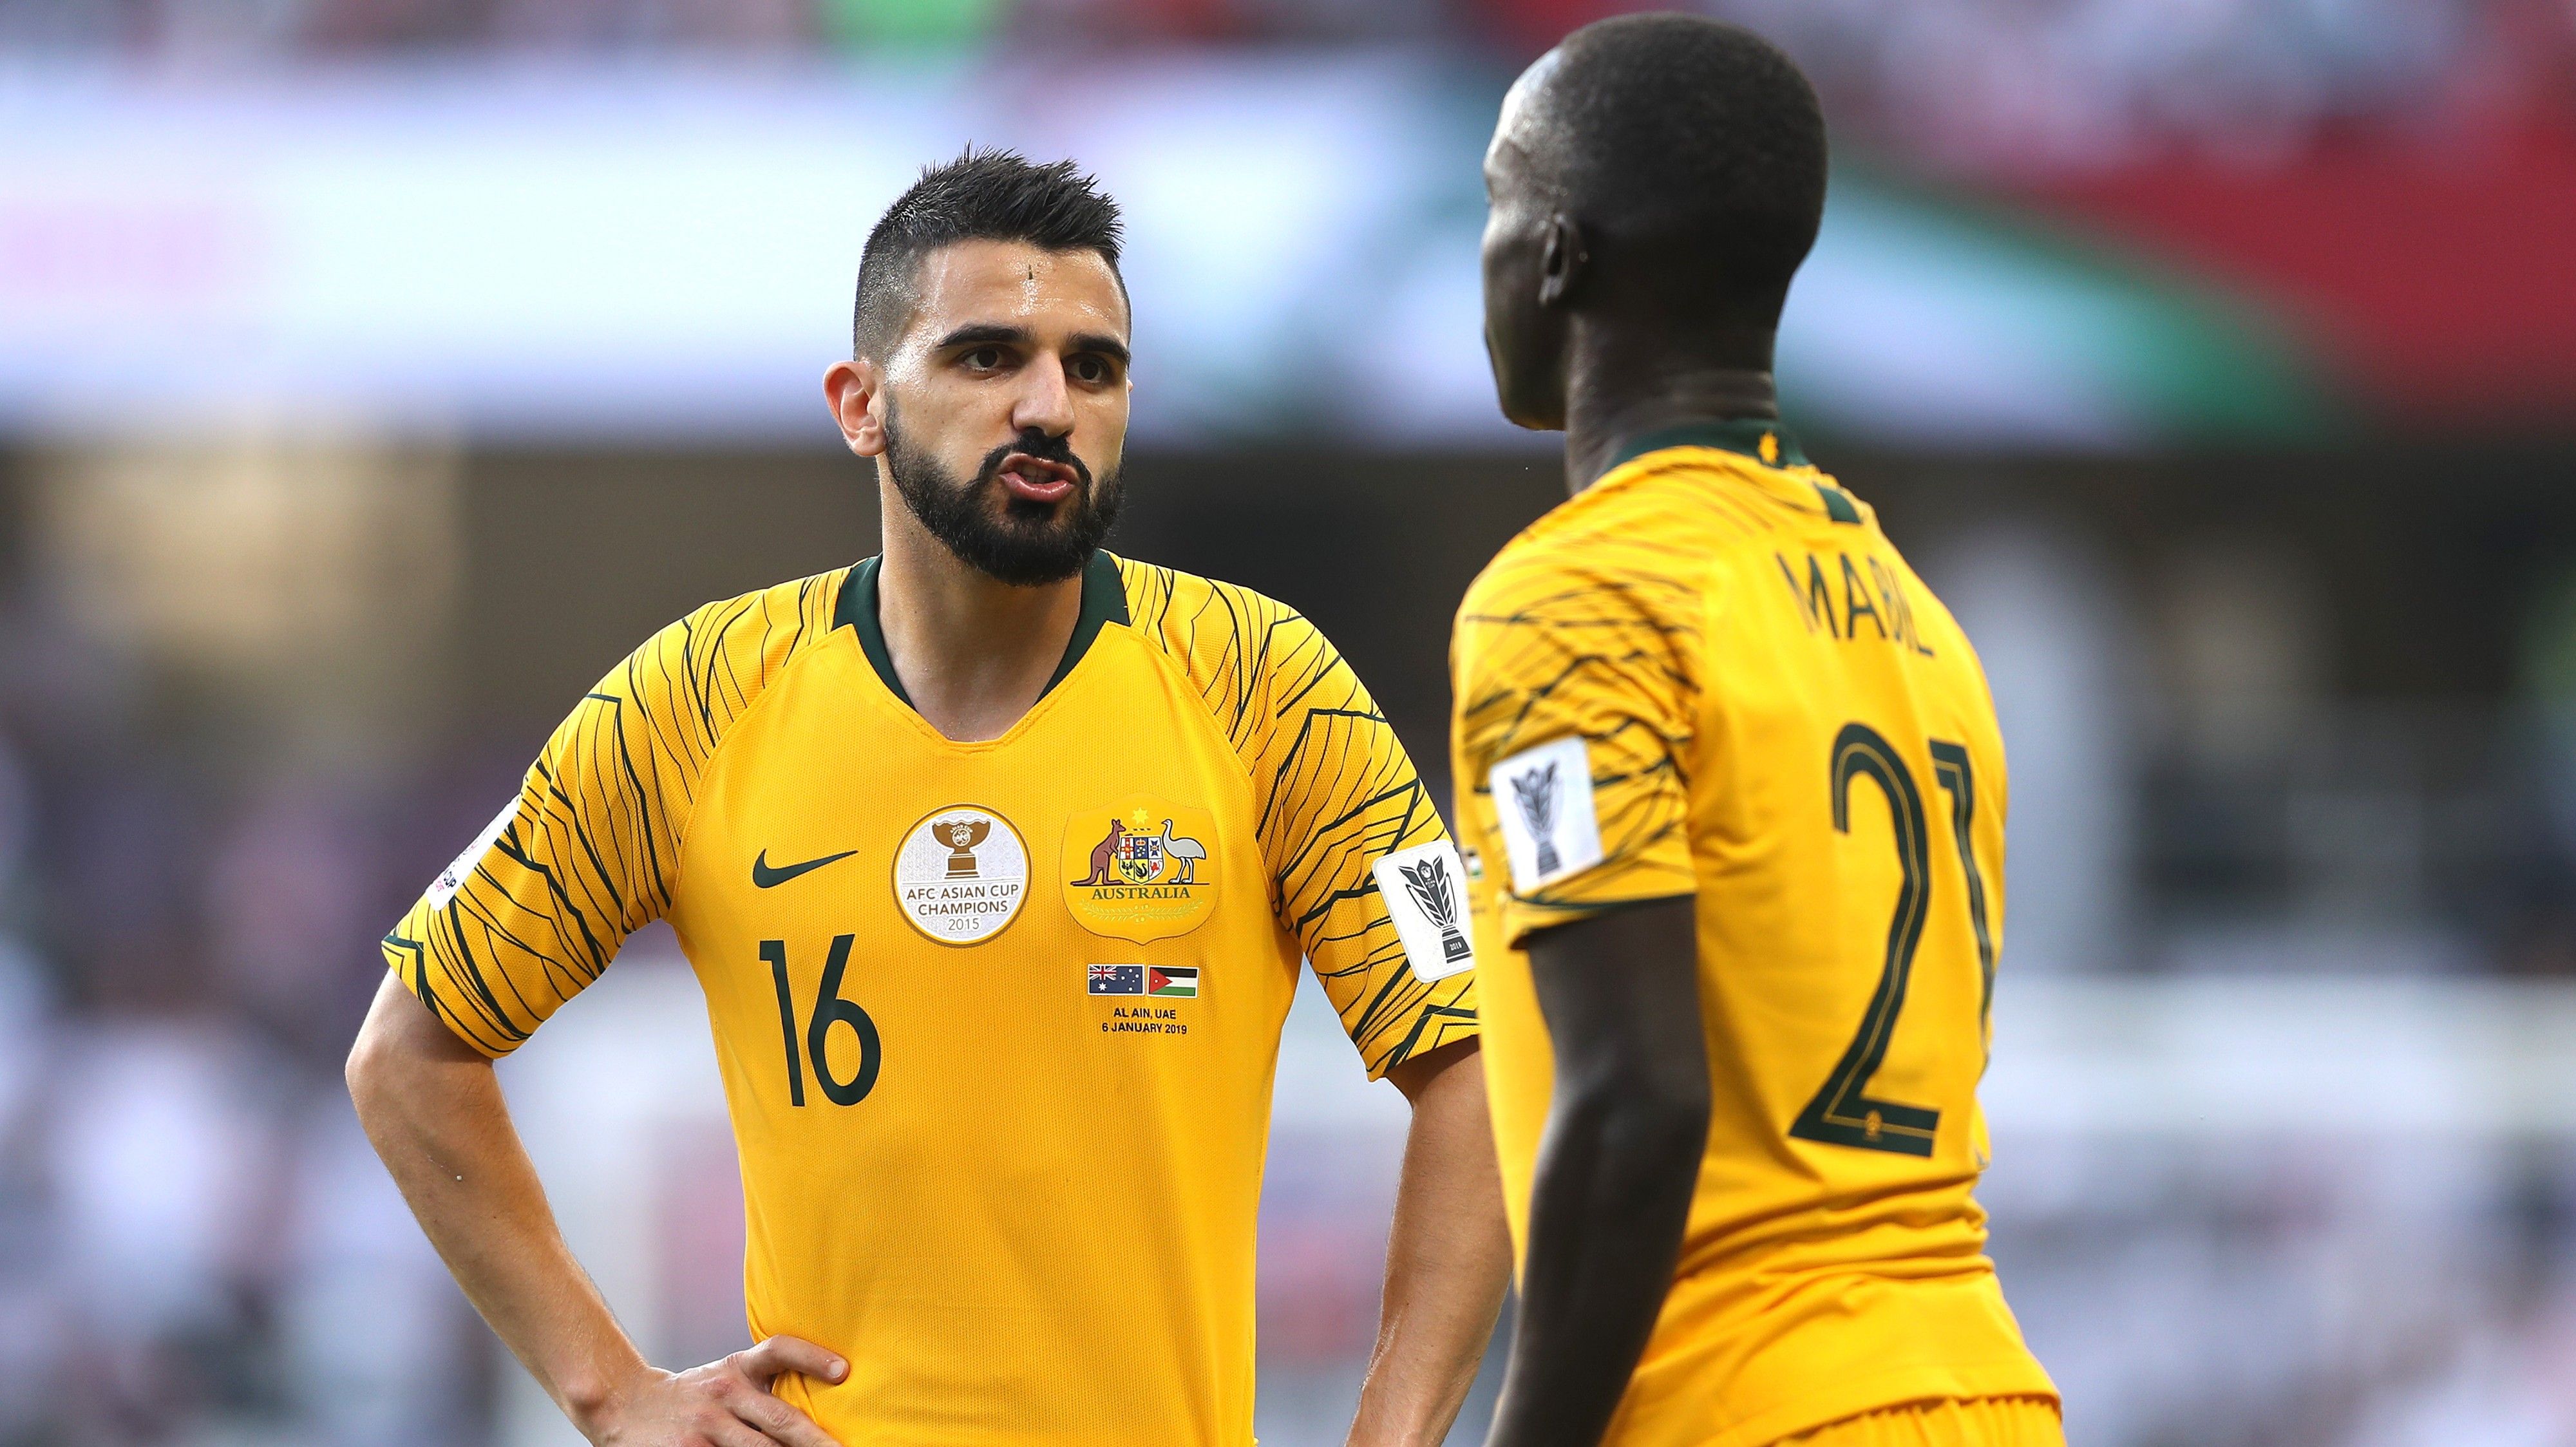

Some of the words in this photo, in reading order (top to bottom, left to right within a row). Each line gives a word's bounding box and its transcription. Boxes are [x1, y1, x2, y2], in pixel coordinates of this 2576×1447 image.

[907, 888, 935, 900] AFC
[941, 886, 985, 899] ASIAN
[990, 884, 1019, 897] CUP
[1092, 887, 1190, 900] AUSTRALIA
[918, 900, 1007, 915] CHAMPIONS
[949, 918, 979, 931] 2015
[1788, 721, 1994, 1158] 21
[759, 934, 881, 1106] 16
[1113, 1007, 1129, 1017] AL
[1132, 1008, 1153, 1019] AIN,
[1155, 1009, 1177, 1019] UAE
[1102, 1022, 1108, 1032] 6
[1112, 1023, 1162, 1033] JANUARY
[1165, 1024, 1188, 1034] 2019
